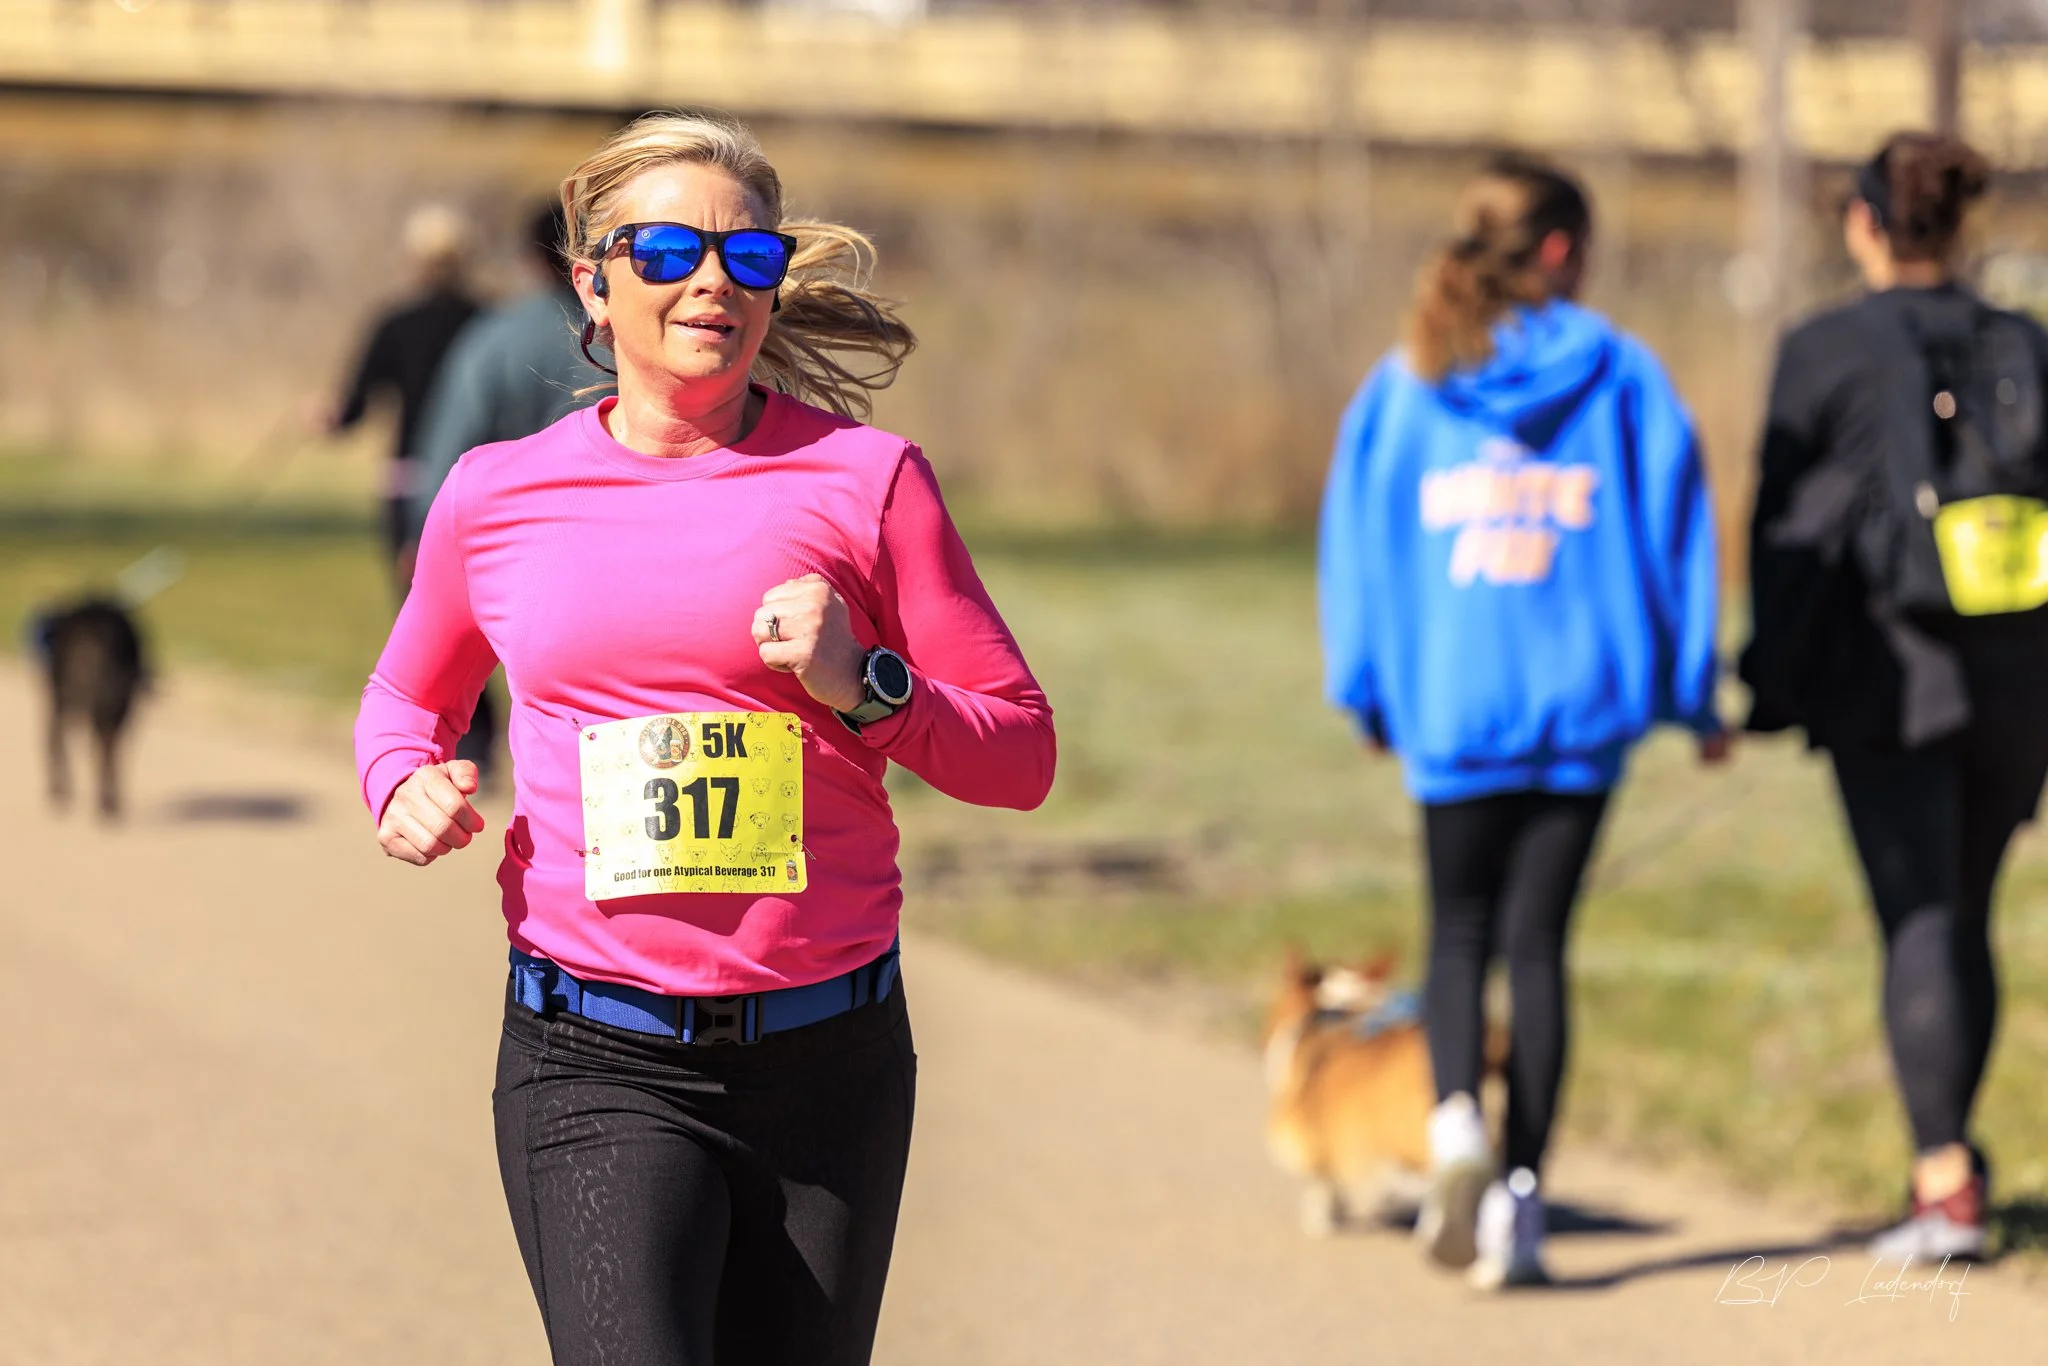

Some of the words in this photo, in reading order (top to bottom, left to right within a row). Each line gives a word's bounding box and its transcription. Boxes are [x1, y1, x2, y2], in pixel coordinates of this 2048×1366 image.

[702, 722, 748, 759] 5K
[643, 777, 740, 841] 317
[614, 869, 636, 882] Good
[638, 868, 652, 878] for
[653, 867, 672, 877] one
[674, 865, 713, 877] Atypical
[715, 865, 758, 878] Beverage
[760, 866, 776, 877] 317
